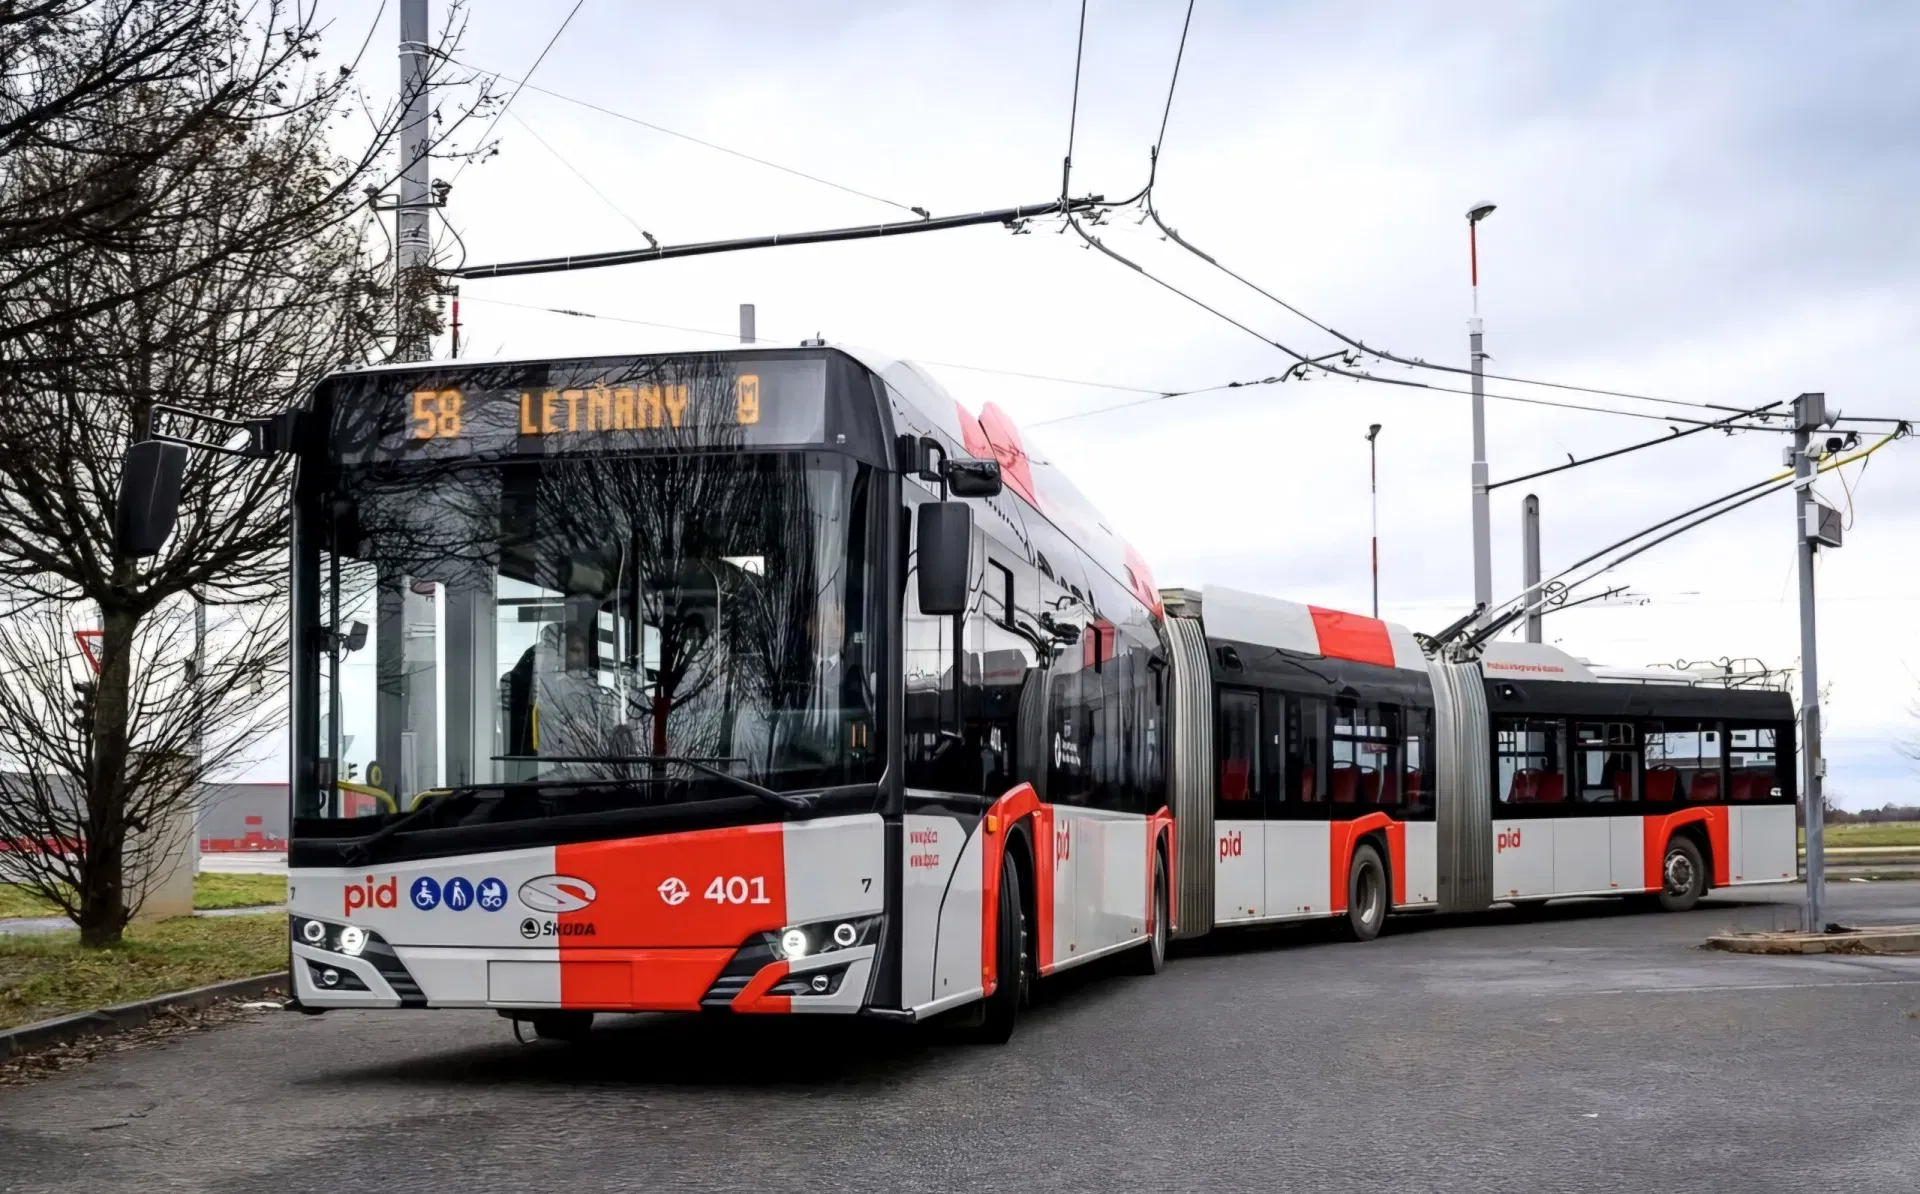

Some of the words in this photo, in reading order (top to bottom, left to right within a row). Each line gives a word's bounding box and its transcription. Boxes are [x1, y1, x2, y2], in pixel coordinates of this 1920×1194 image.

[412, 389, 461, 439] 58
[520, 378, 688, 434] LETŇANY
[1056, 819, 1070, 872] pid
[1219, 830, 1242, 864] pid
[1498, 827, 1521, 854] pid
[344, 875, 398, 918] pid
[703, 876, 771, 905] 401
[861, 878, 873, 894] 7
[543, 920, 597, 937] ŠKODA
